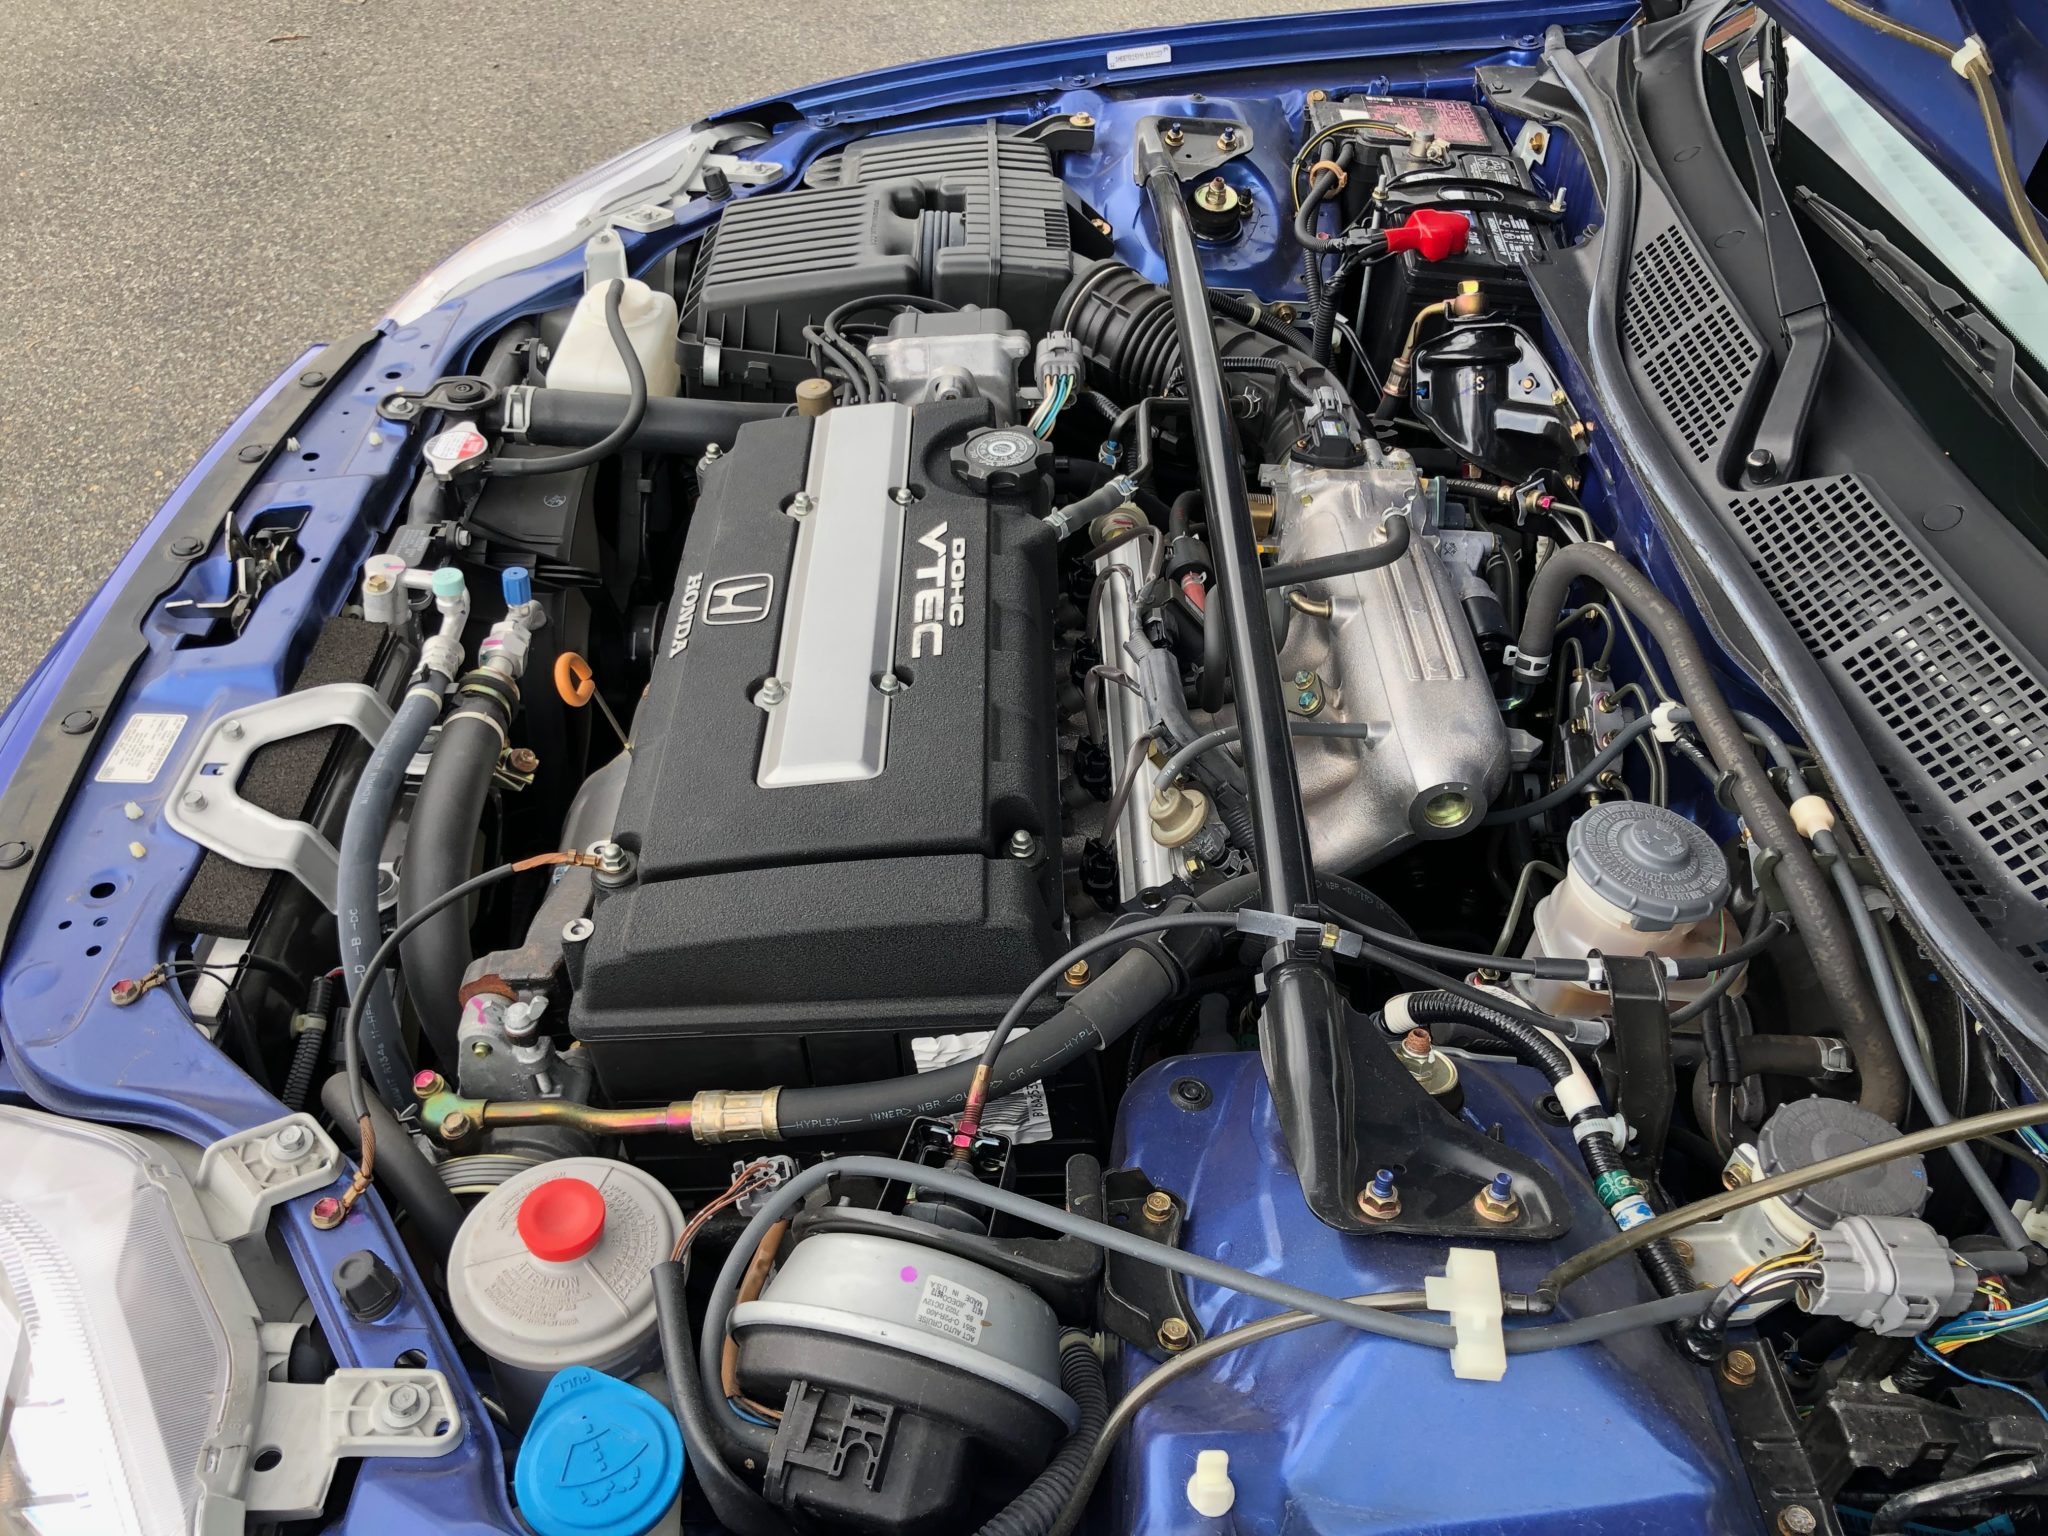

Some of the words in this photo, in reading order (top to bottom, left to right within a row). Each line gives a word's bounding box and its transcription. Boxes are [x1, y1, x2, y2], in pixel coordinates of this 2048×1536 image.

[947, 537, 966, 628] DOHC
[911, 521, 949, 660] VTEC
[668, 571, 704, 660] HONDA
[918, 1100, 941, 1112] NBR
[952, 1289, 959, 1297] IN
[918, 1315, 943, 1328] CRUISE
[943, 1323, 961, 1336] AUTO
[961, 1332, 975, 1342] ACT
